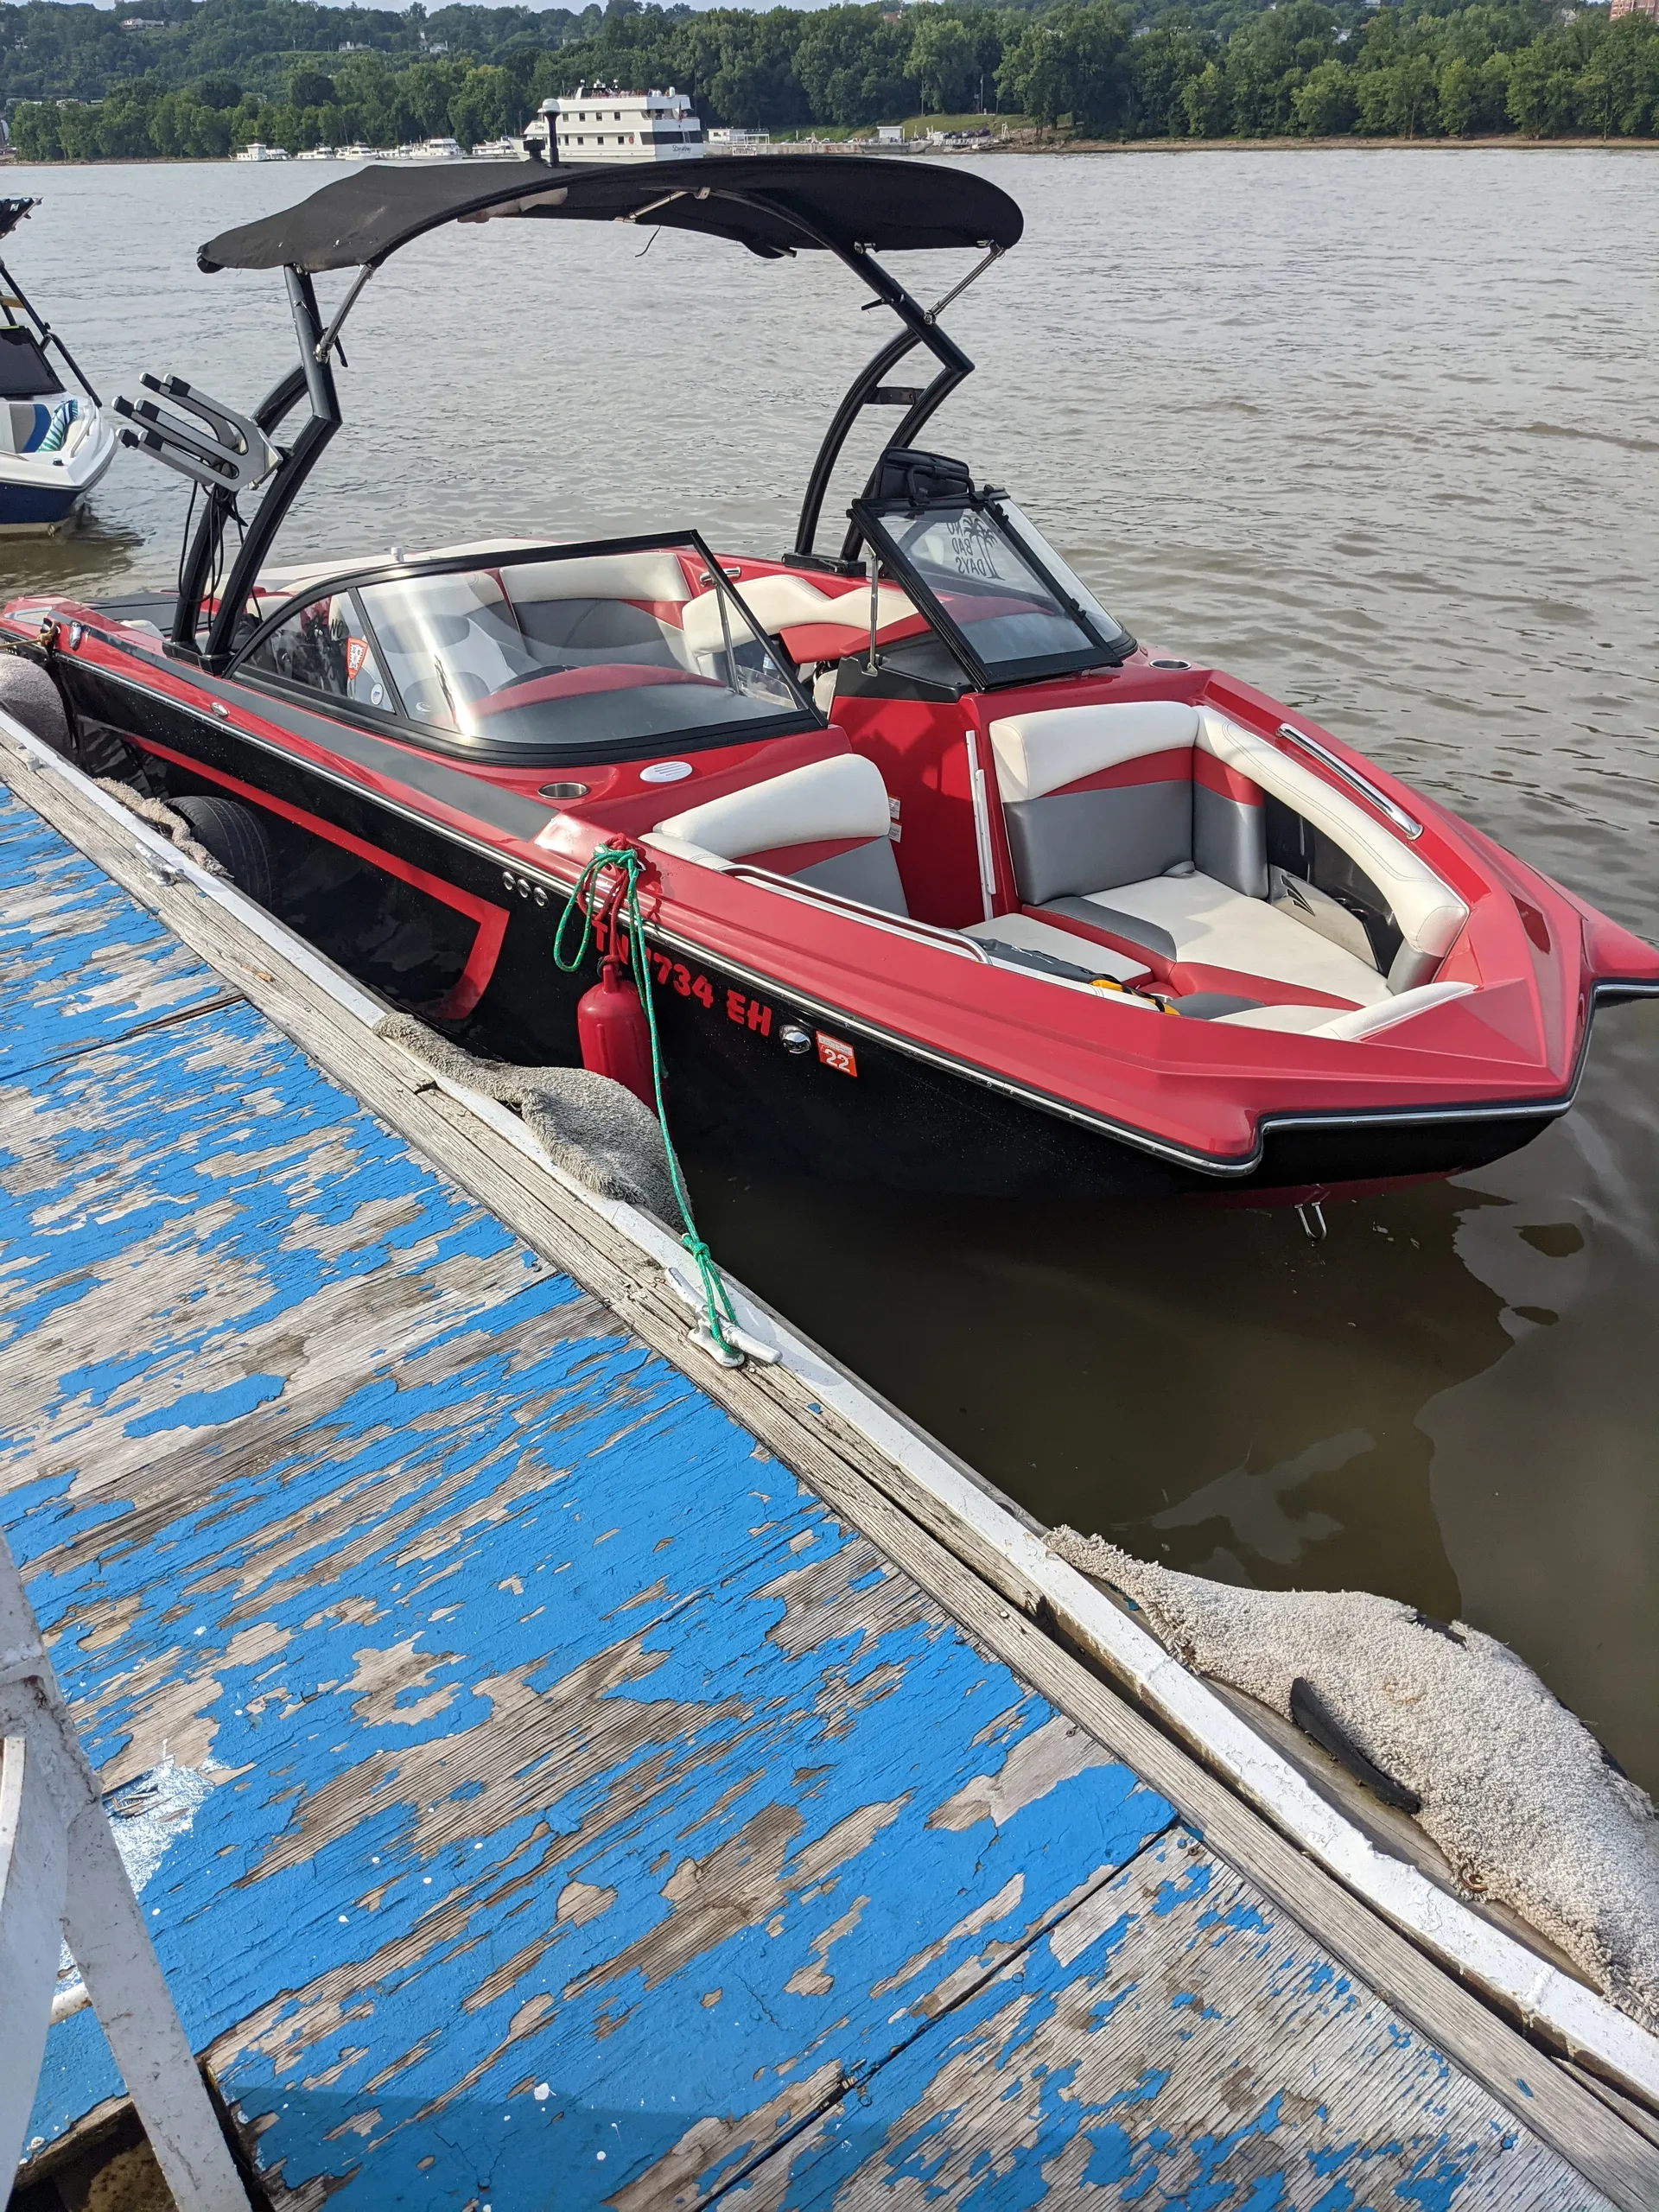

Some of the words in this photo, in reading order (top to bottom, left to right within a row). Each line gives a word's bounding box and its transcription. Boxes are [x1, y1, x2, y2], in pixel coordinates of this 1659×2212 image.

[330, 618, 343, 639] NO
[727, 988, 772, 1037] EH
[824, 1048, 850, 1073] 22
